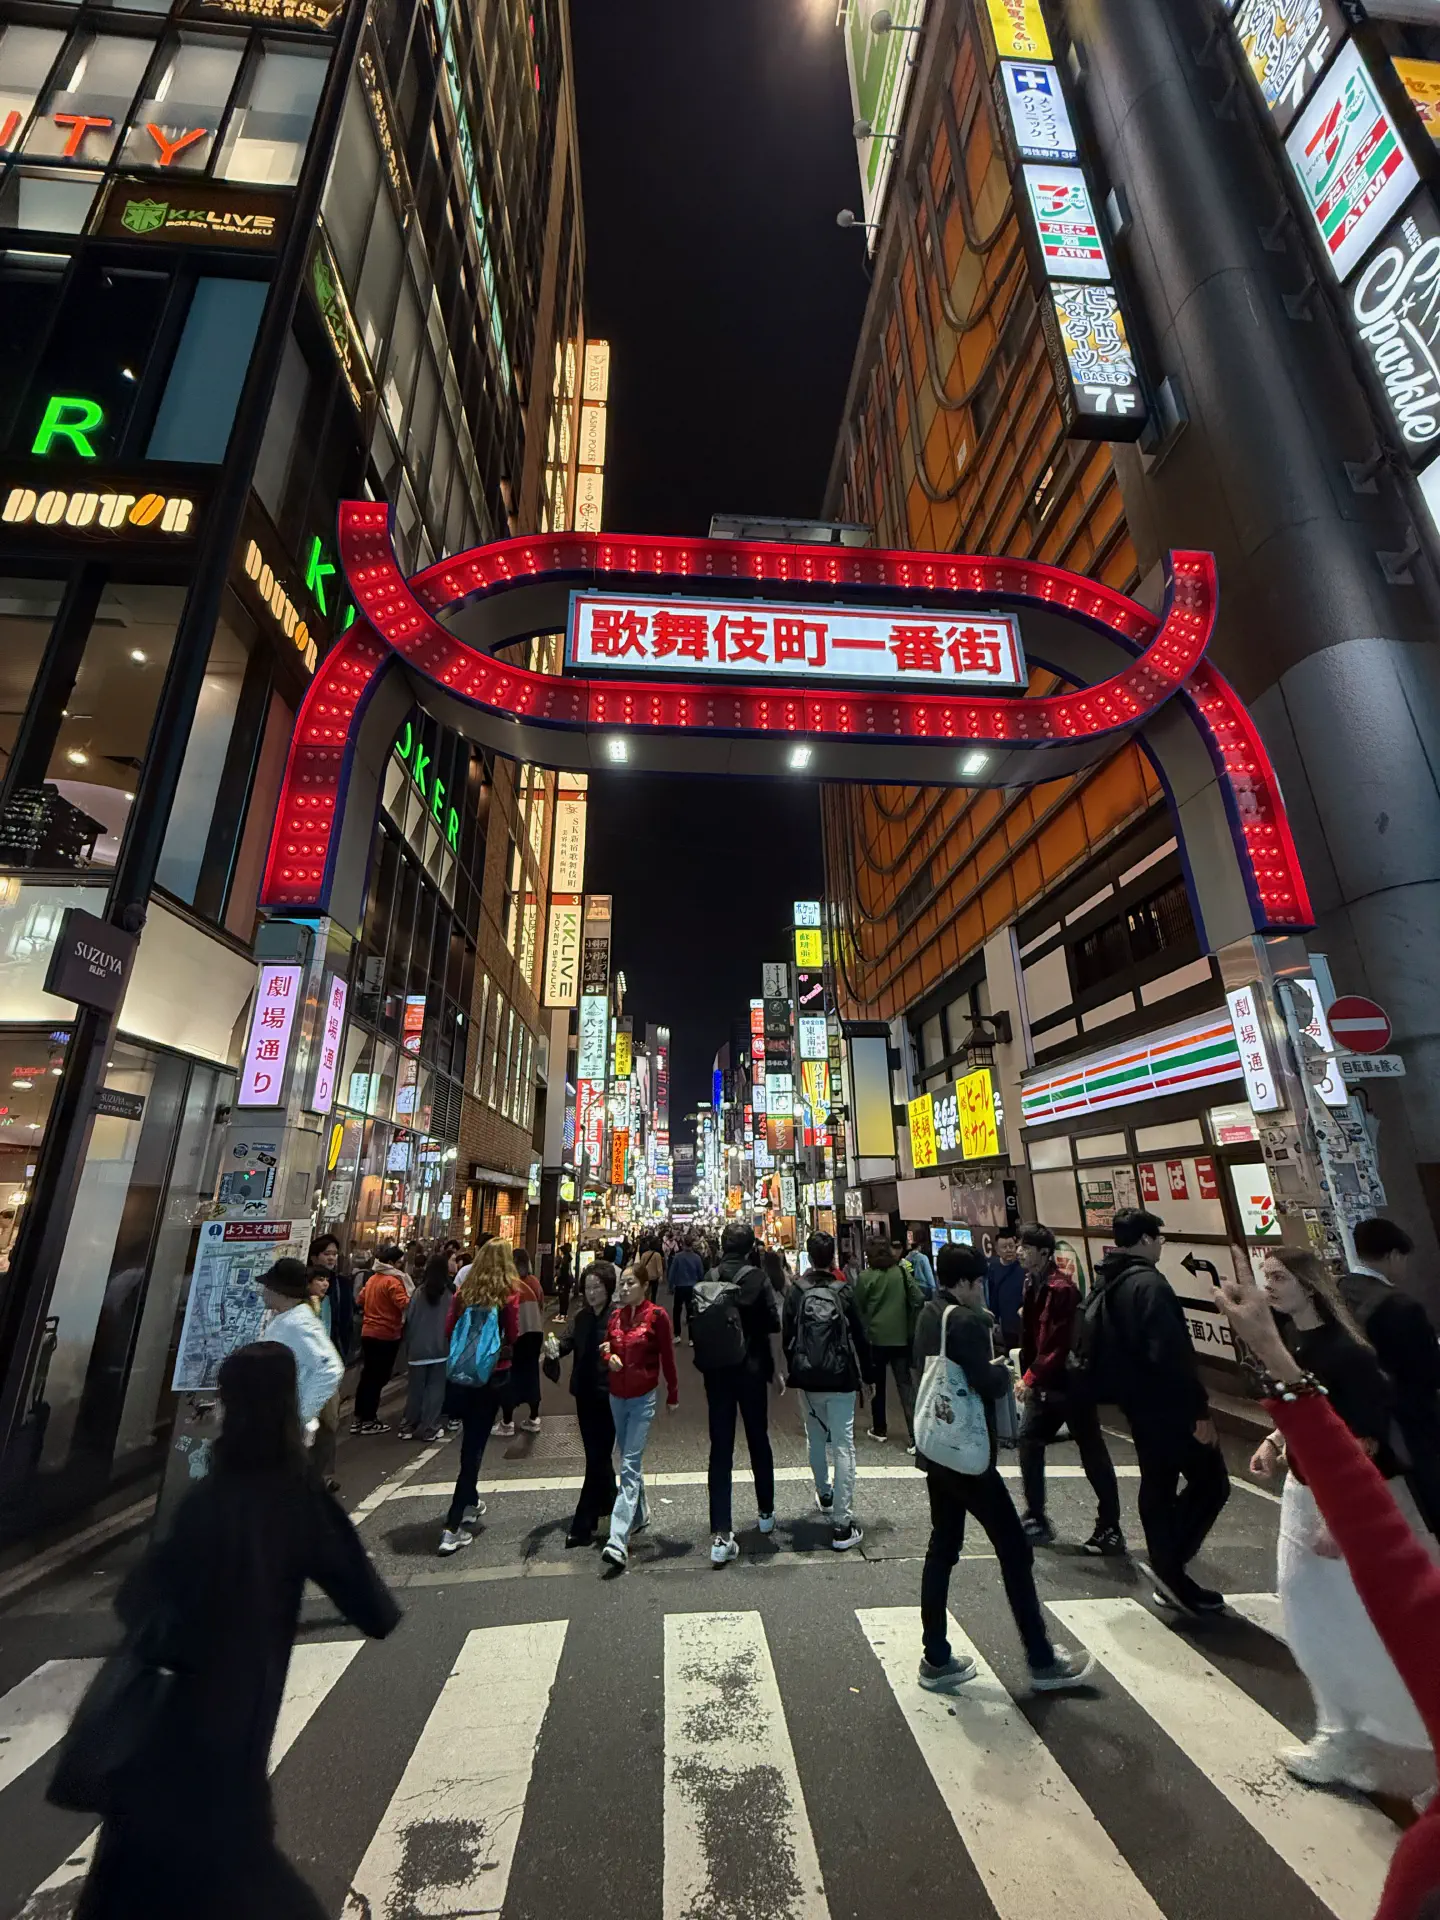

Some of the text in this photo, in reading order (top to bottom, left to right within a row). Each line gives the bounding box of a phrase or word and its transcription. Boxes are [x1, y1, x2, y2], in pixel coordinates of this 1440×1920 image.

[1023, 95, 1042, 138] クリニック
[1061, 149, 1077, 160] 3F
[1327, 134, 1377, 210] たばこ
[168, 208, 275, 227] KKLIVE
[1342, 168, 1387, 234] ATM
[165, 220, 272, 235] POKER SHINJUKU
[1048, 223, 1088, 236] たばこ
[1056, 249, 1091, 258] ATM
[589, 366, 600, 392] ABYSS
[1084, 386, 1135, 414] 7F
[31, 397, 103, 458] R
[588, 410, 598, 462] CASINO POKER
[2, 489, 194, 532] DOUTOR
[244, 540, 318, 674] DOUTOR
[591, 609, 1001, 675] 歌舞伎町一番街
[572, 896, 579, 905] 3
[796, 903, 818, 914] ポケット
[801, 915, 815, 924] ビル
[74, 941, 122, 975] SUZUYA
[560, 914, 577, 997] KKLIVE
[253, 975, 291, 1094] 劇場通り
[318, 986, 345, 1100] 劇場通り
[584, 1018, 596, 1062] バンタイ
[1235, 996, 1268, 1100] 劇場通り
[1341, 1059, 1402, 1074] 自転車を除く
[101, 1093, 126, 1104] SUZUYA
[814, 1063, 824, 1109] ハイボール
[967, 1074, 990, 1112] ビール
[98, 1104, 132, 1115] ENTRANCE
[969, 1120, 995, 1154] サワー
[1141, 1164, 1216, 1192] たばこ
